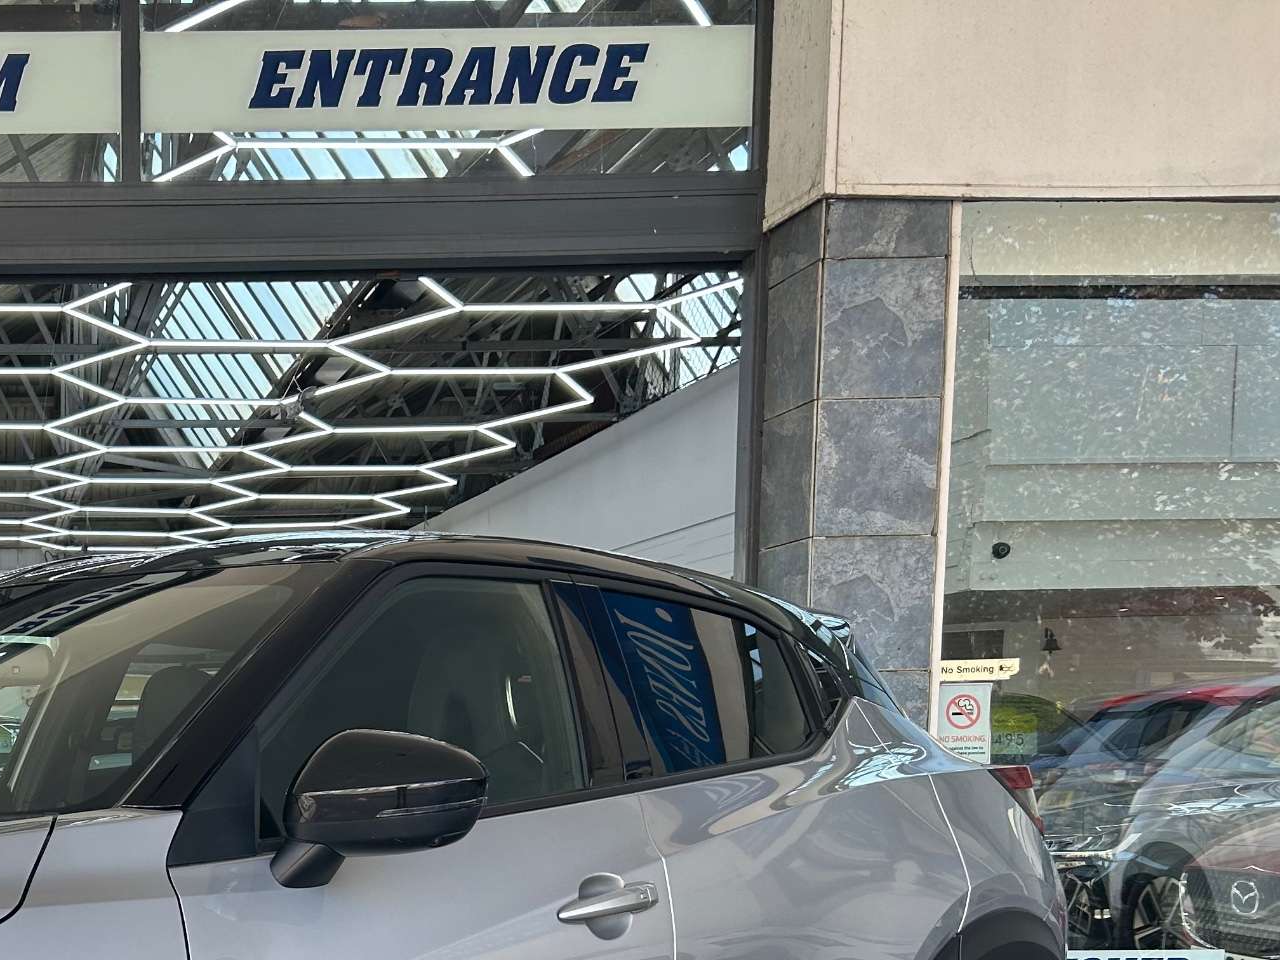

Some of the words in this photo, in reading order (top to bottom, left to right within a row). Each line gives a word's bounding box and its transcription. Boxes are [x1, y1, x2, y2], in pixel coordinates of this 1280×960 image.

[247, 43, 650, 109] ENTRANCE
[956, 665, 995, 674] Smoking
[950, 735, 986, 743] SMOKING
